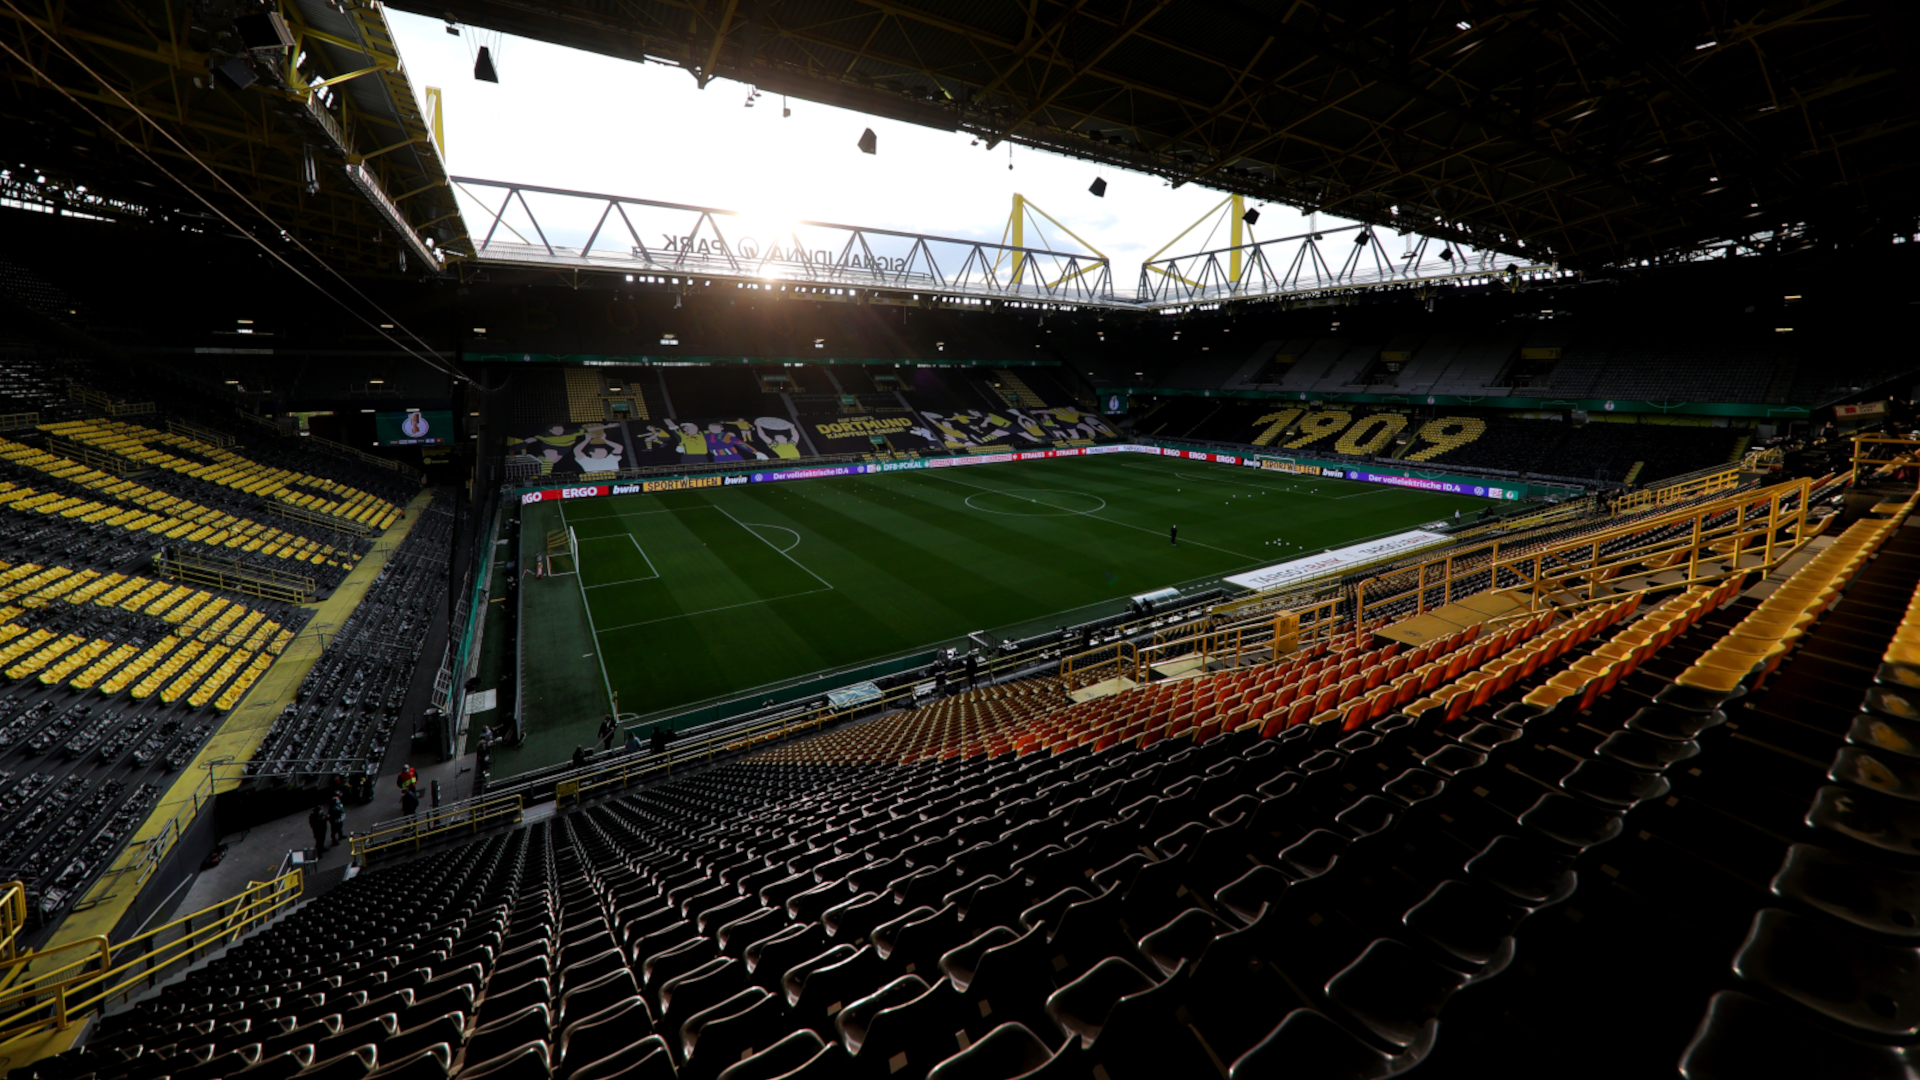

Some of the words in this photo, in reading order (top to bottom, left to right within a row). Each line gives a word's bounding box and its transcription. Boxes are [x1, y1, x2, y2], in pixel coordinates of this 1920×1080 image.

[815, 417, 912, 434] DORTMUND
[1251, 408, 1487, 462] 1909
[1164, 449, 1180, 457] ERGO
[1189, 452, 1207, 460] ERGO
[1216, 455, 1236, 464] ERGO
[786, 468, 836, 479] vollelektrische
[835, 467, 849, 475] ID.4
[1322, 467, 1343, 478] bwin
[647, 477, 718, 492] SPORTWETTEN
[723, 476, 748, 486] bwin
[1383, 475, 1442, 490] vollelektrische
[1443, 484, 1461, 492] ID.4
[562, 486, 598, 499] ERGO
[612, 483, 640, 495] bwin
